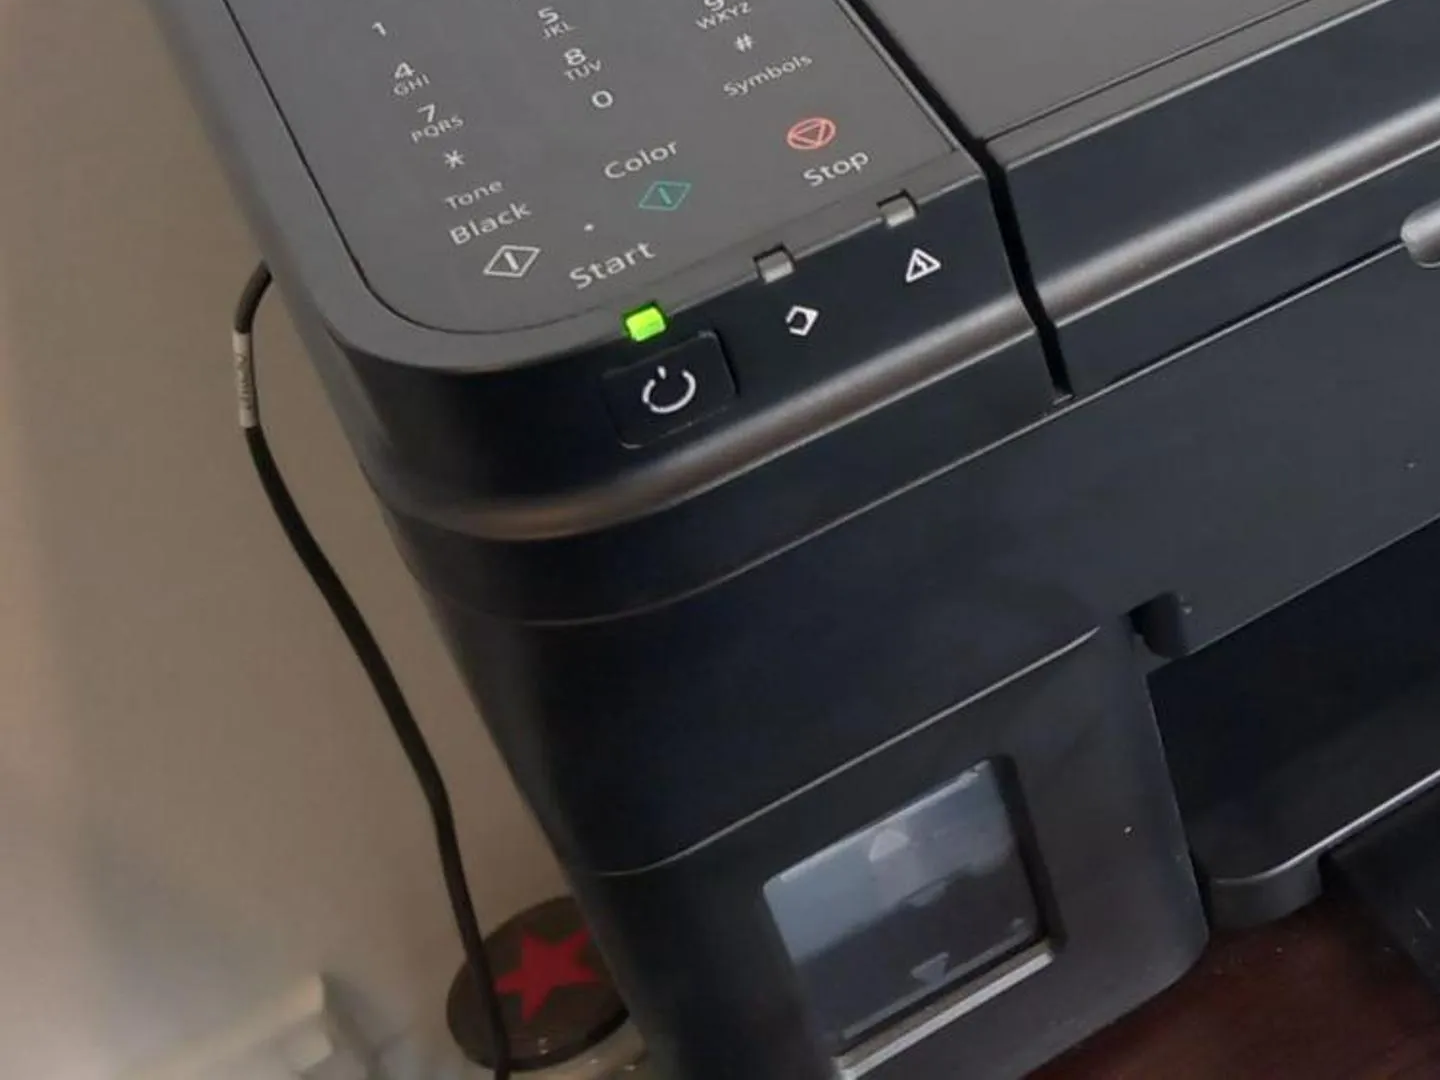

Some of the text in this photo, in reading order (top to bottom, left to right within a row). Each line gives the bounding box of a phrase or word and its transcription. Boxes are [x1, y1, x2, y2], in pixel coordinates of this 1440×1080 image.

[371, 21, 388, 37] 1
[537, 6, 559, 25] 5
[695, 1, 753, 30] WXYZ
[564, 48, 586, 66] 8
[734, 32, 753, 53] #
[394, 62, 416, 80] 4
[564, 59, 602, 81] TUV
[722, 55, 813, 97] Symbols
[416, 103, 436, 124] 7
[410, 115, 464, 145] PQRS
[604, 140, 679, 180] Color
[803, 151, 870, 188] Stop
[445, 180, 504, 211] Tone
[449, 202, 533, 246] Black
[569, 240, 656, 291] Start
